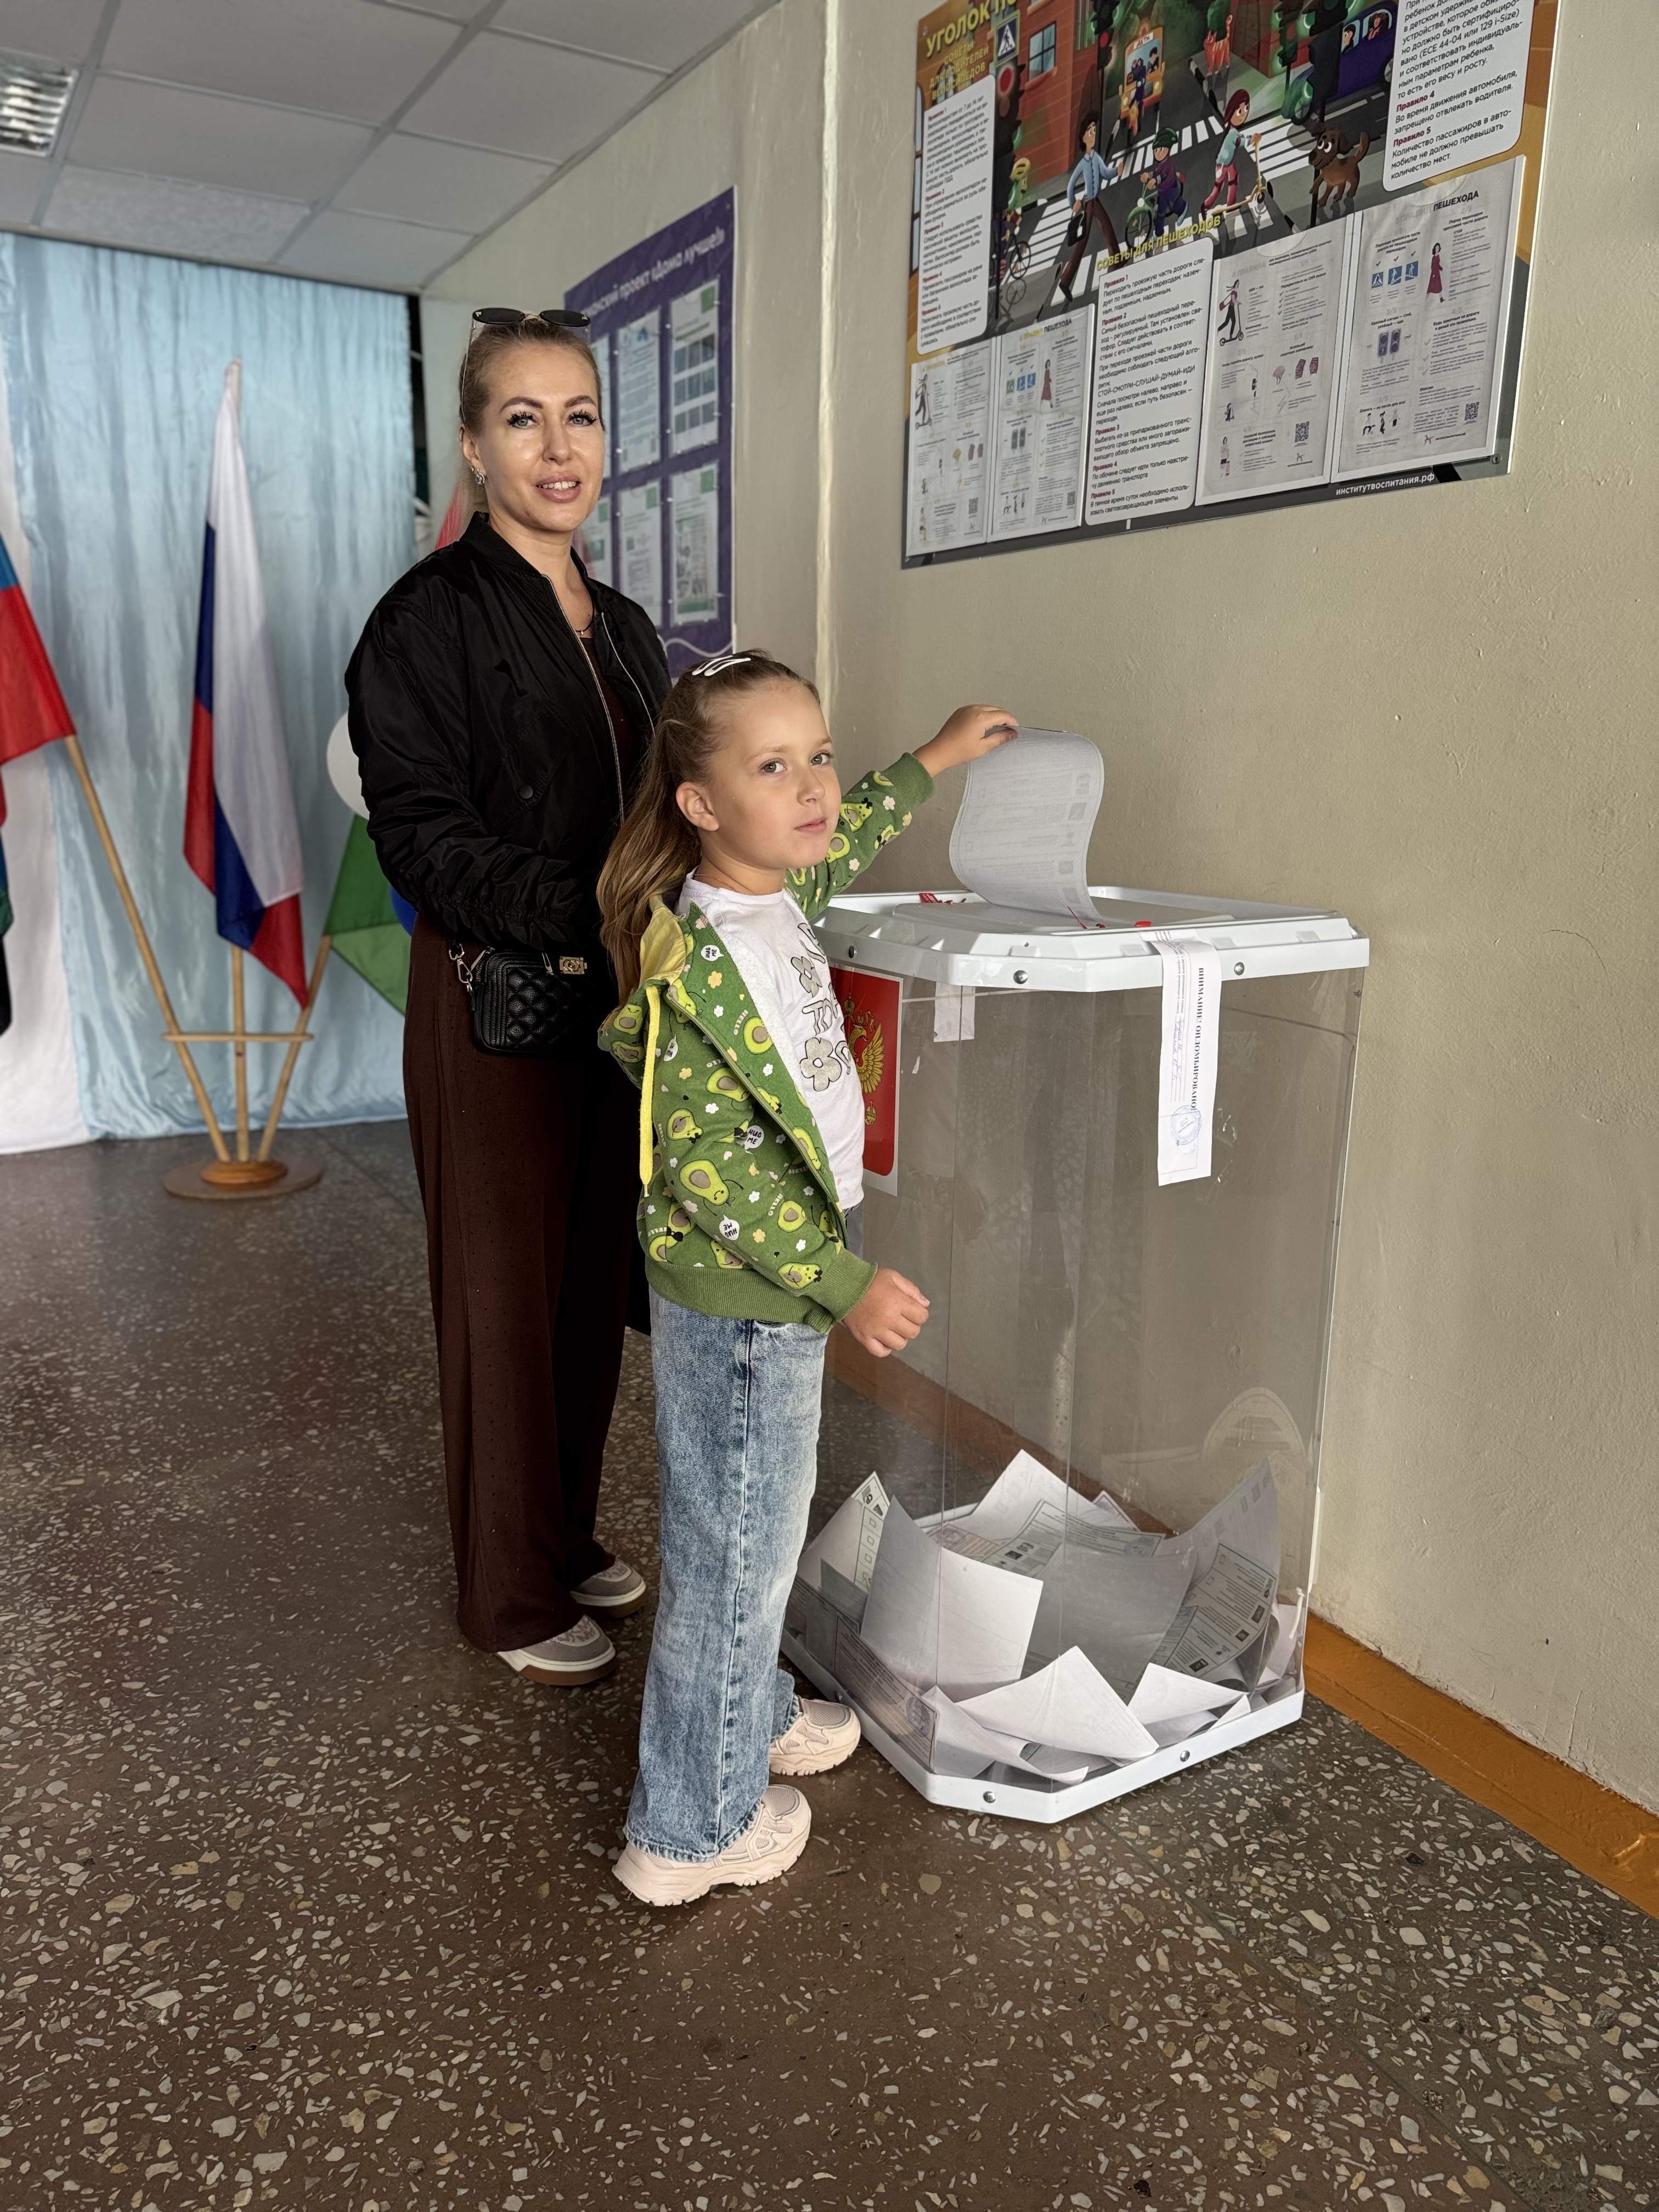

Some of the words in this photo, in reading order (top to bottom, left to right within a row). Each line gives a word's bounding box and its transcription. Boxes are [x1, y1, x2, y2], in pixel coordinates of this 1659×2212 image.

[1402, 20, 1444, 45] устройстве,
[1447, 4, 1478, 24] которое
[1402, 46, 1410, 55] но
[1412, 33, 1440, 51] должно
[1442, 25, 1460, 36] быть
[1462, 0, 1519, 27] сертифициро-
[1404, 2, 1435, 22] ребенок
[1409, 12, 1438, 31] детском
[926, 0, 990, 58] УГОЛОК
[1401, 54, 1417, 66] вано
[1439, 33, 1461, 48] 44-04
[1464, 27, 1478, 38] или
[1481, 20, 1492, 31] 129
[944, 41, 974, 65] СОВЕТЫ
[1406, 45, 1466, 74] соответствовать
[1468, 21, 1522, 48] индивидуаль-
[929, 72, 944, 89] ДЛЯ
[946, 44, 989, 78] ВОДИТЕЛЕЙ
[932, 61, 986, 100] ВЕЛОСИПЕДОВ
[1398, 77, 1413, 88] ным
[1415, 58, 1458, 81] параметрам
[1460, 44, 1494, 64] ребенка,
[1407, 85, 1423, 95] есть
[1424, 78, 1436, 88] его
[1438, 70, 1455, 82] весу
[1464, 57, 1487, 73] росту.
[1394, 114, 1434, 134] запрещено
[1436, 100, 1472, 117] отвлекать
[1475, 83, 1513, 103] водителя.
[1396, 95, 1427, 112] Правило
[1407, 105, 1428, 119] время
[1430, 90, 1466, 111] движения
[1469, 71, 1516, 94] автомобиля,
[1391, 155, 1417, 169] мобиле
[1429, 139, 1458, 156] должно
[1460, 123, 1503, 144] превышать
[1392, 138, 1434, 158] Количество
[1436, 120, 1481, 142] пассажиров
[1490, 110, 1511, 121] авто-
[1393, 130, 1424, 146] Правило
[1391, 160, 1431, 179] количество
[1433, 153, 1451, 164] мест.
[1433, 190, 1480, 212] ПЕШЕХОДА
[1096, 249, 1133, 272] СОВЕТЫ
[1134, 240, 1154, 258] ДЛЯ
[1156, 216, 1221, 247] ПЕШЕХОДОВ
[1103, 284, 1131, 297] Переходить
[1132, 274, 1157, 287] проезжую
[1173, 262, 1192, 273] дороги
[1103, 298, 1113, 307] дует
[1121, 285, 1152, 300] пешеходным
[1153, 274, 1181, 288] переходам:
[1183, 269, 1201, 278] назем-
[1104, 277, 1125, 288] Правило
[1043, 318, 1073, 334] ПЕШЕХОДА
[1101, 324, 1116, 334] Самый
[1118, 314, 1146, 329] безопасный
[1147, 303, 1179, 319] пешеходный
[1102, 315, 1122, 325] Правило
[1114, 323, 1148, 340] регулируемый.
[1160, 311, 1189, 325] установлен
[1117, 336, 1136, 346] Следует
[1137, 327, 1167, 341] действовать
[1173, 318, 1195, 329] соответ-
[1109, 358, 1131, 368] переходе
[1132, 349, 1156, 362] проезжей
[1172, 340, 1192, 350] дороги
[1097, 399, 1116, 408] Сначала
[1117, 392, 1139, 402] посмотри
[1141, 387, 1159, 396] налево,
[1160, 381, 1182, 391] направо
[1098, 365, 1195, 397] СТОЙ-СМОТРИ-СЛУШАЙ-ДУМАЙ-ИДИ
[1116, 403, 1133, 411] налево;
[1159, 389, 1186, 400] безопасен
[1335, 472, 1435, 496] институтвоспитания.рф
[1195, 967, 1205, 1023] ВНИМАНИЕ!
[733, 1009, 749, 1036] HELLO
[1191, 1025, 1202, 1111] ОПЛОМБИРОВАНО!
[748, 1128, 761, 1138] HUG
